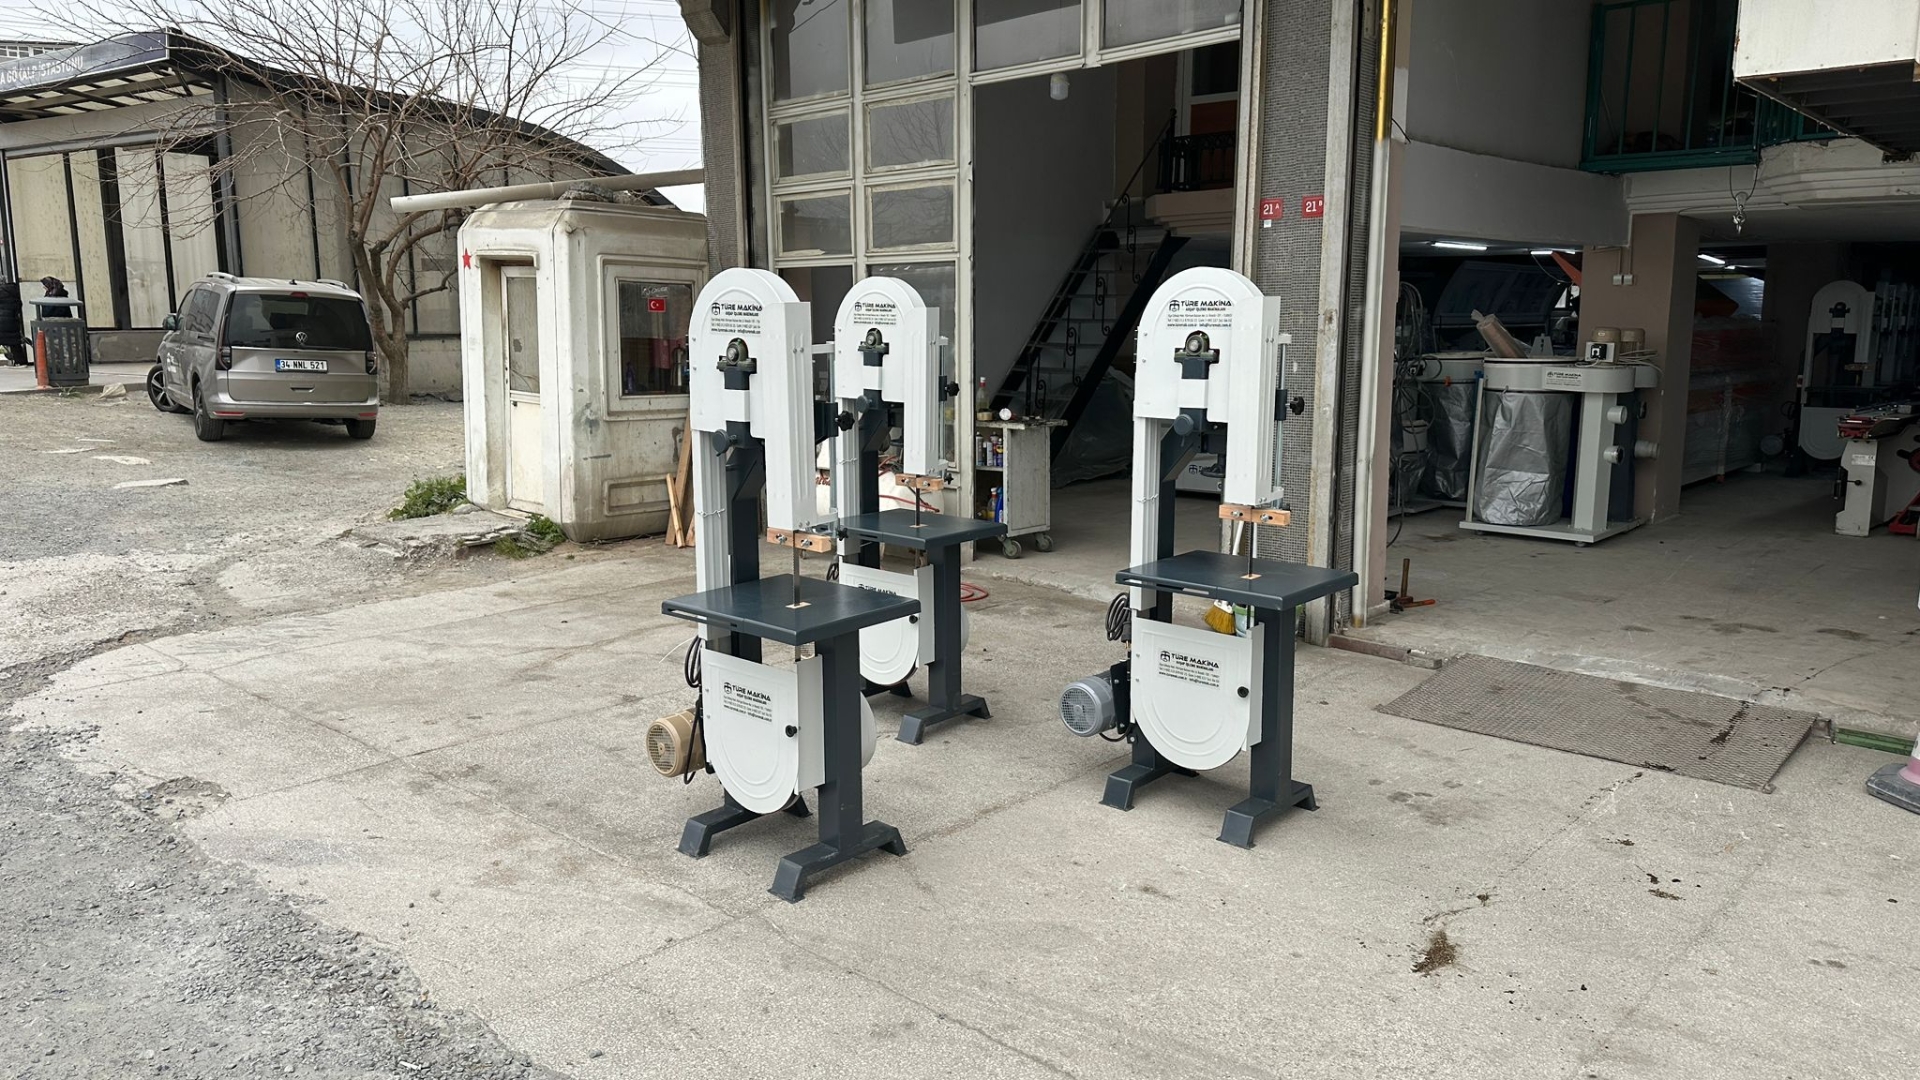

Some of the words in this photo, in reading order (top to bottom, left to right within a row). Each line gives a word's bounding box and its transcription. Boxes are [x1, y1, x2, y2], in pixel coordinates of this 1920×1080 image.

[1263, 204, 1274, 215] 21
[1305, 201, 1317, 213] 21
[280, 360, 290, 368] 34
[293, 361, 307, 369] NNL
[310, 361, 324, 369] 521
[1189, 657, 1219, 669] MAKİNA
[747, 689, 771, 702] MAKİNA
